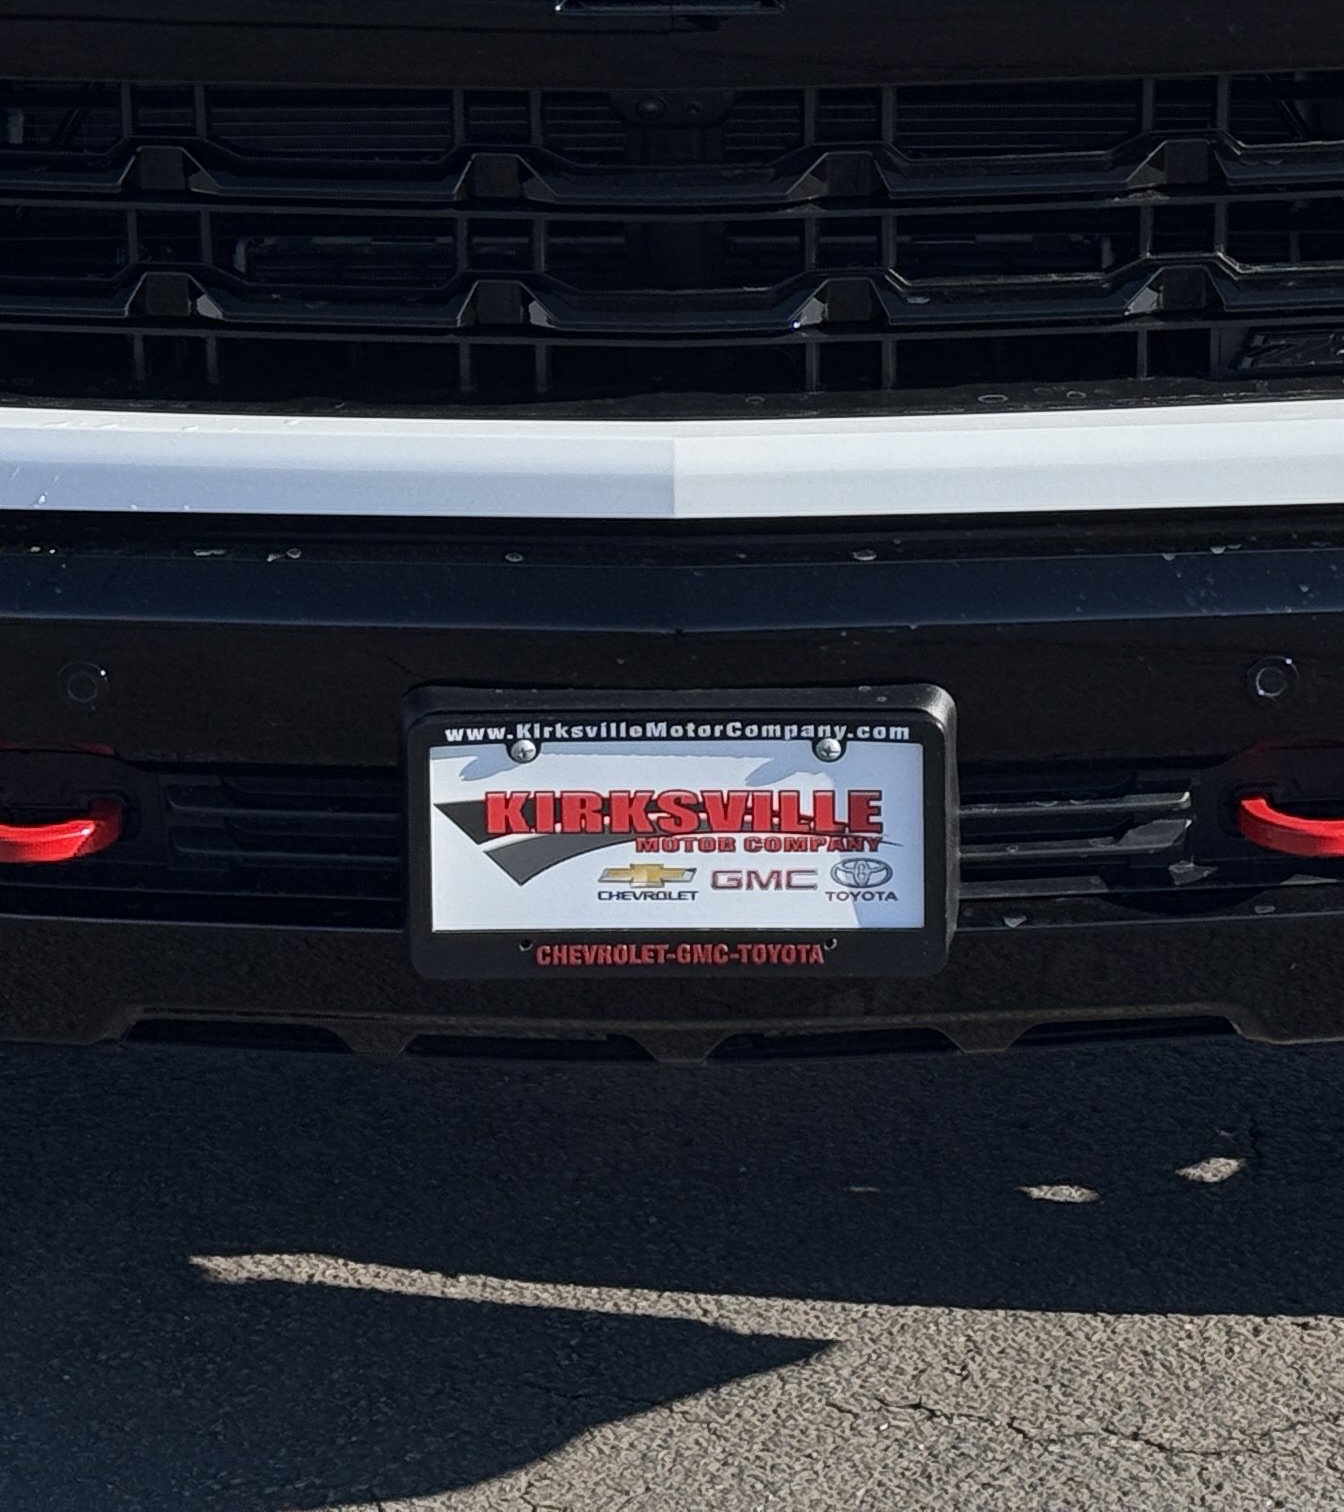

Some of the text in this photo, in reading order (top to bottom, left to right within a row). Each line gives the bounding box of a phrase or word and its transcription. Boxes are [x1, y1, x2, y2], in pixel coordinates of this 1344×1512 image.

[445, 721, 910, 741] www.KirksvilleMotorCompany.com
[484, 789, 884, 834] KIRKSVILLE
[635, 837, 882, 853] MOTOR COMPANY
[711, 869, 818, 891] GMC
[597, 890, 698, 901] CHEVROLET
[825, 891, 898, 902] TOYOTA
[536, 943, 824, 966] CHEVROLET-GMC-TOYOTA
